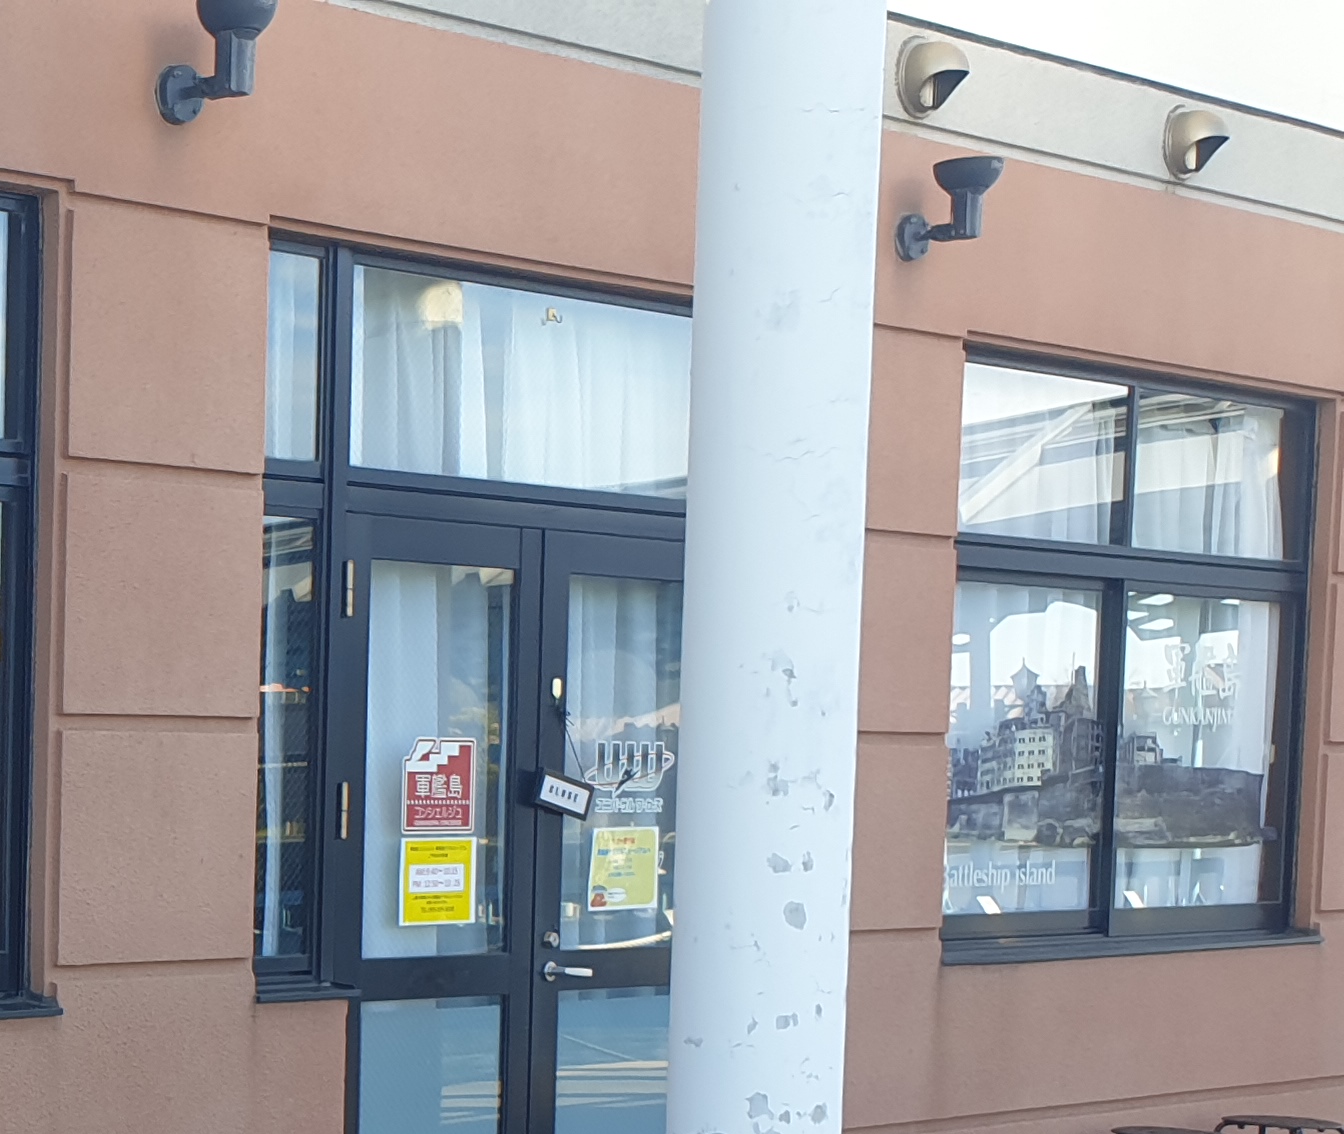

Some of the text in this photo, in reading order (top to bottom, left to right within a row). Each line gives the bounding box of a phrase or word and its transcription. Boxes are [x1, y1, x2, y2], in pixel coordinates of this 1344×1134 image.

[415, 773, 462, 798] 軍艦島
[548, 784, 579, 803] CLOSE
[414, 805, 462, 819] コンシェルジュ
[1016, 859, 1055, 885] island
